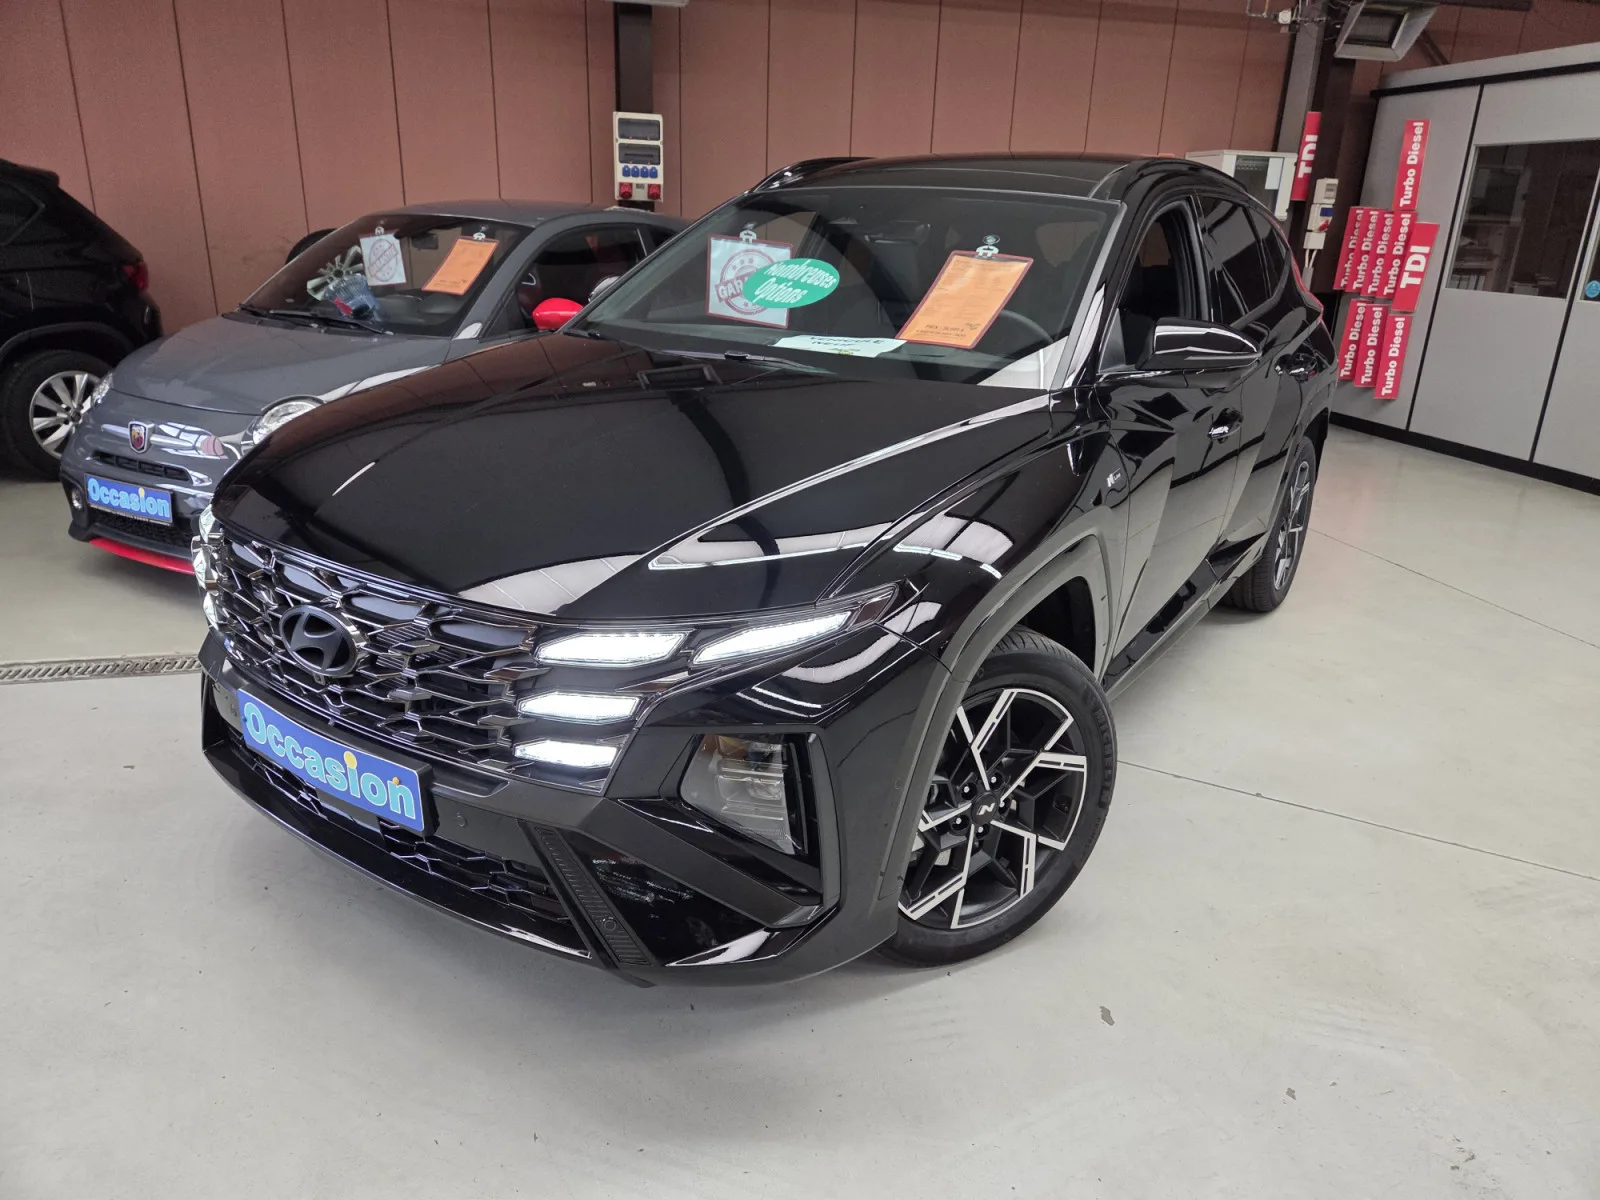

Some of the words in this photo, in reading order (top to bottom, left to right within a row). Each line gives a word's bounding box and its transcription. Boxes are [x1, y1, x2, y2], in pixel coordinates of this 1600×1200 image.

[1406, 121, 1424, 165] Diesel
[1399, 168, 1416, 207] Turbo
[1352, 254, 1369, 290] Turbo
[1361, 210, 1379, 251] Diesel
[1368, 257, 1384, 294] Turbo
[1376, 213, 1394, 254] Diesel
[1383, 258, 1401, 295] Turbo
[1392, 213, 1411, 255] Diesel
[1400, 245, 1430, 289] TDI
[752, 277, 808, 304] Options
[763, 259, 837, 289] Nombreuses
[1348, 302, 1367, 341] Diesel
[1366, 307, 1383, 346] Diesel
[1388, 317, 1405, 357] Diesel
[1340, 343, 1357, 377] Turbo
[1361, 349, 1376, 384] Turbo
[1381, 360, 1398, 396] Turbo
[87, 478, 170, 518] Occasion
[243, 701, 416, 820] Occasion
